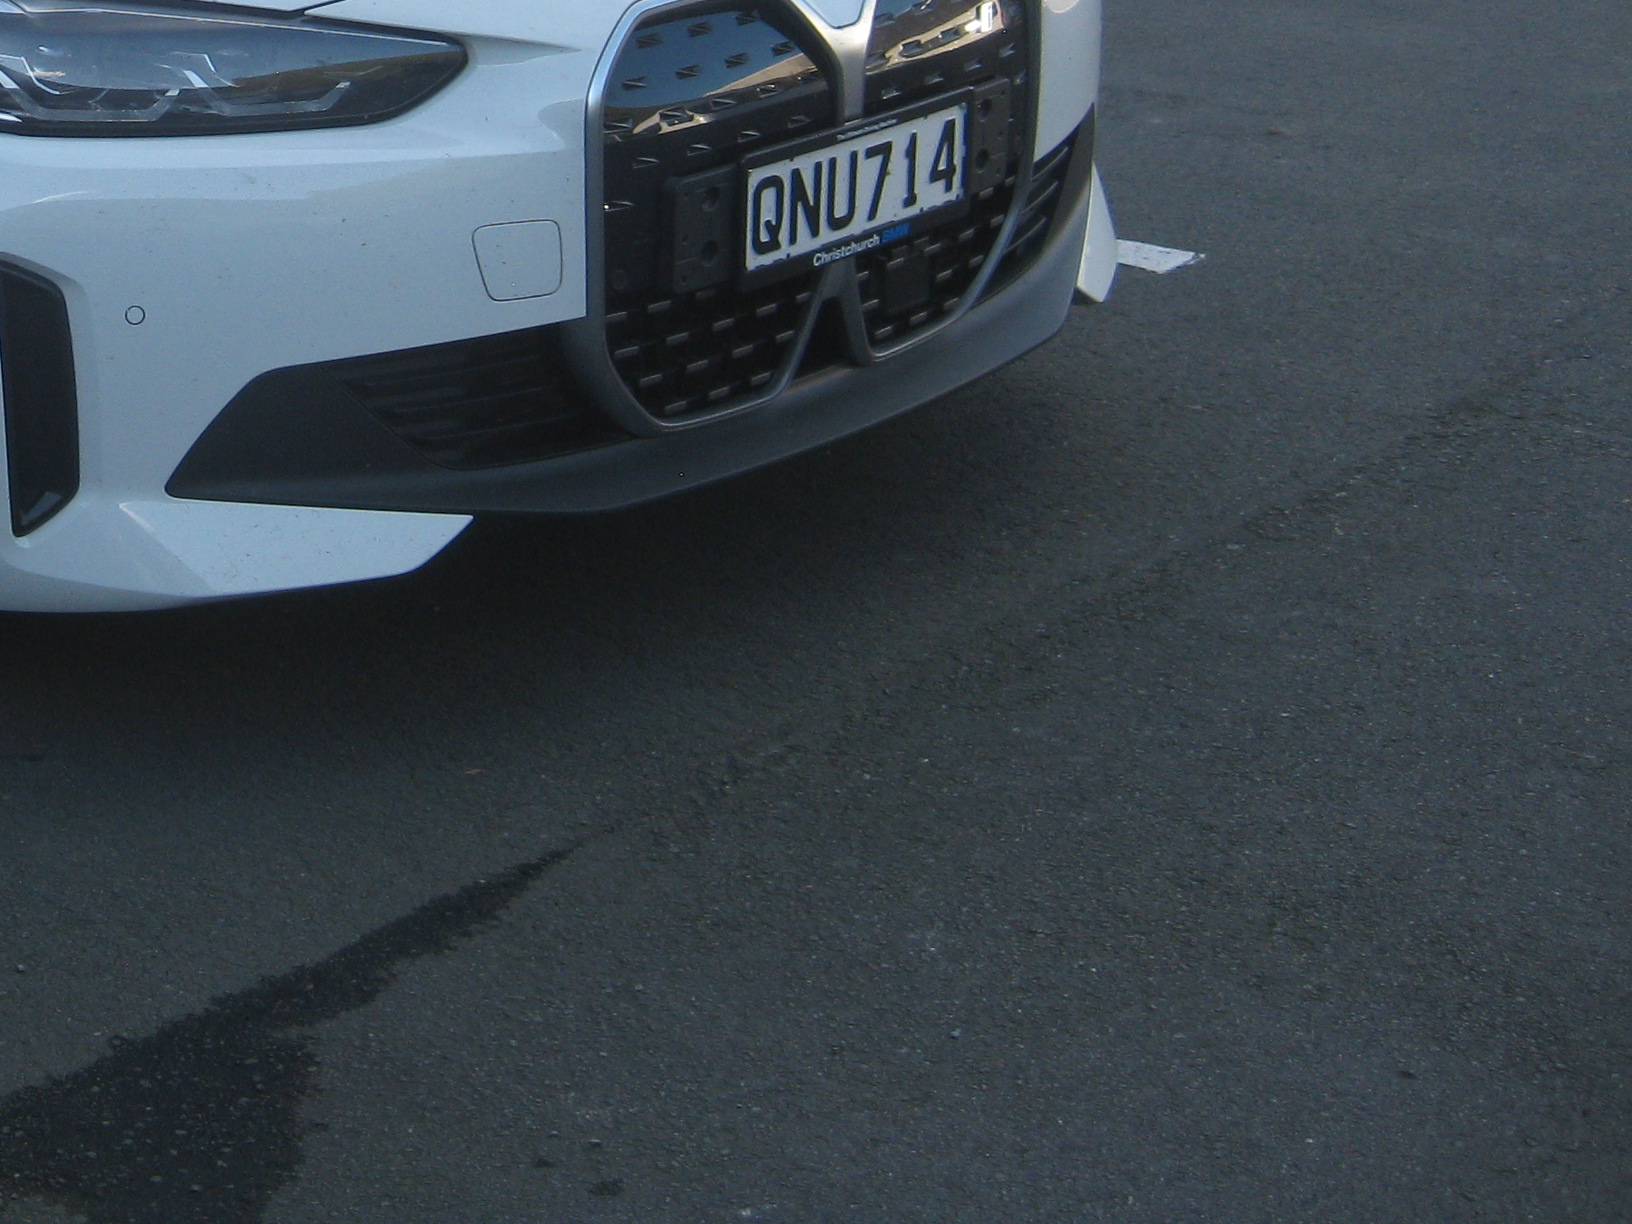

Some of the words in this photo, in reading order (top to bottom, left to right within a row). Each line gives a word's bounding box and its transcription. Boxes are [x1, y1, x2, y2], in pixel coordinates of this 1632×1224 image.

[751, 118, 957, 255] QNU714
[813, 233, 880, 267] Christchurch
[881, 222, 912, 243] BMW
